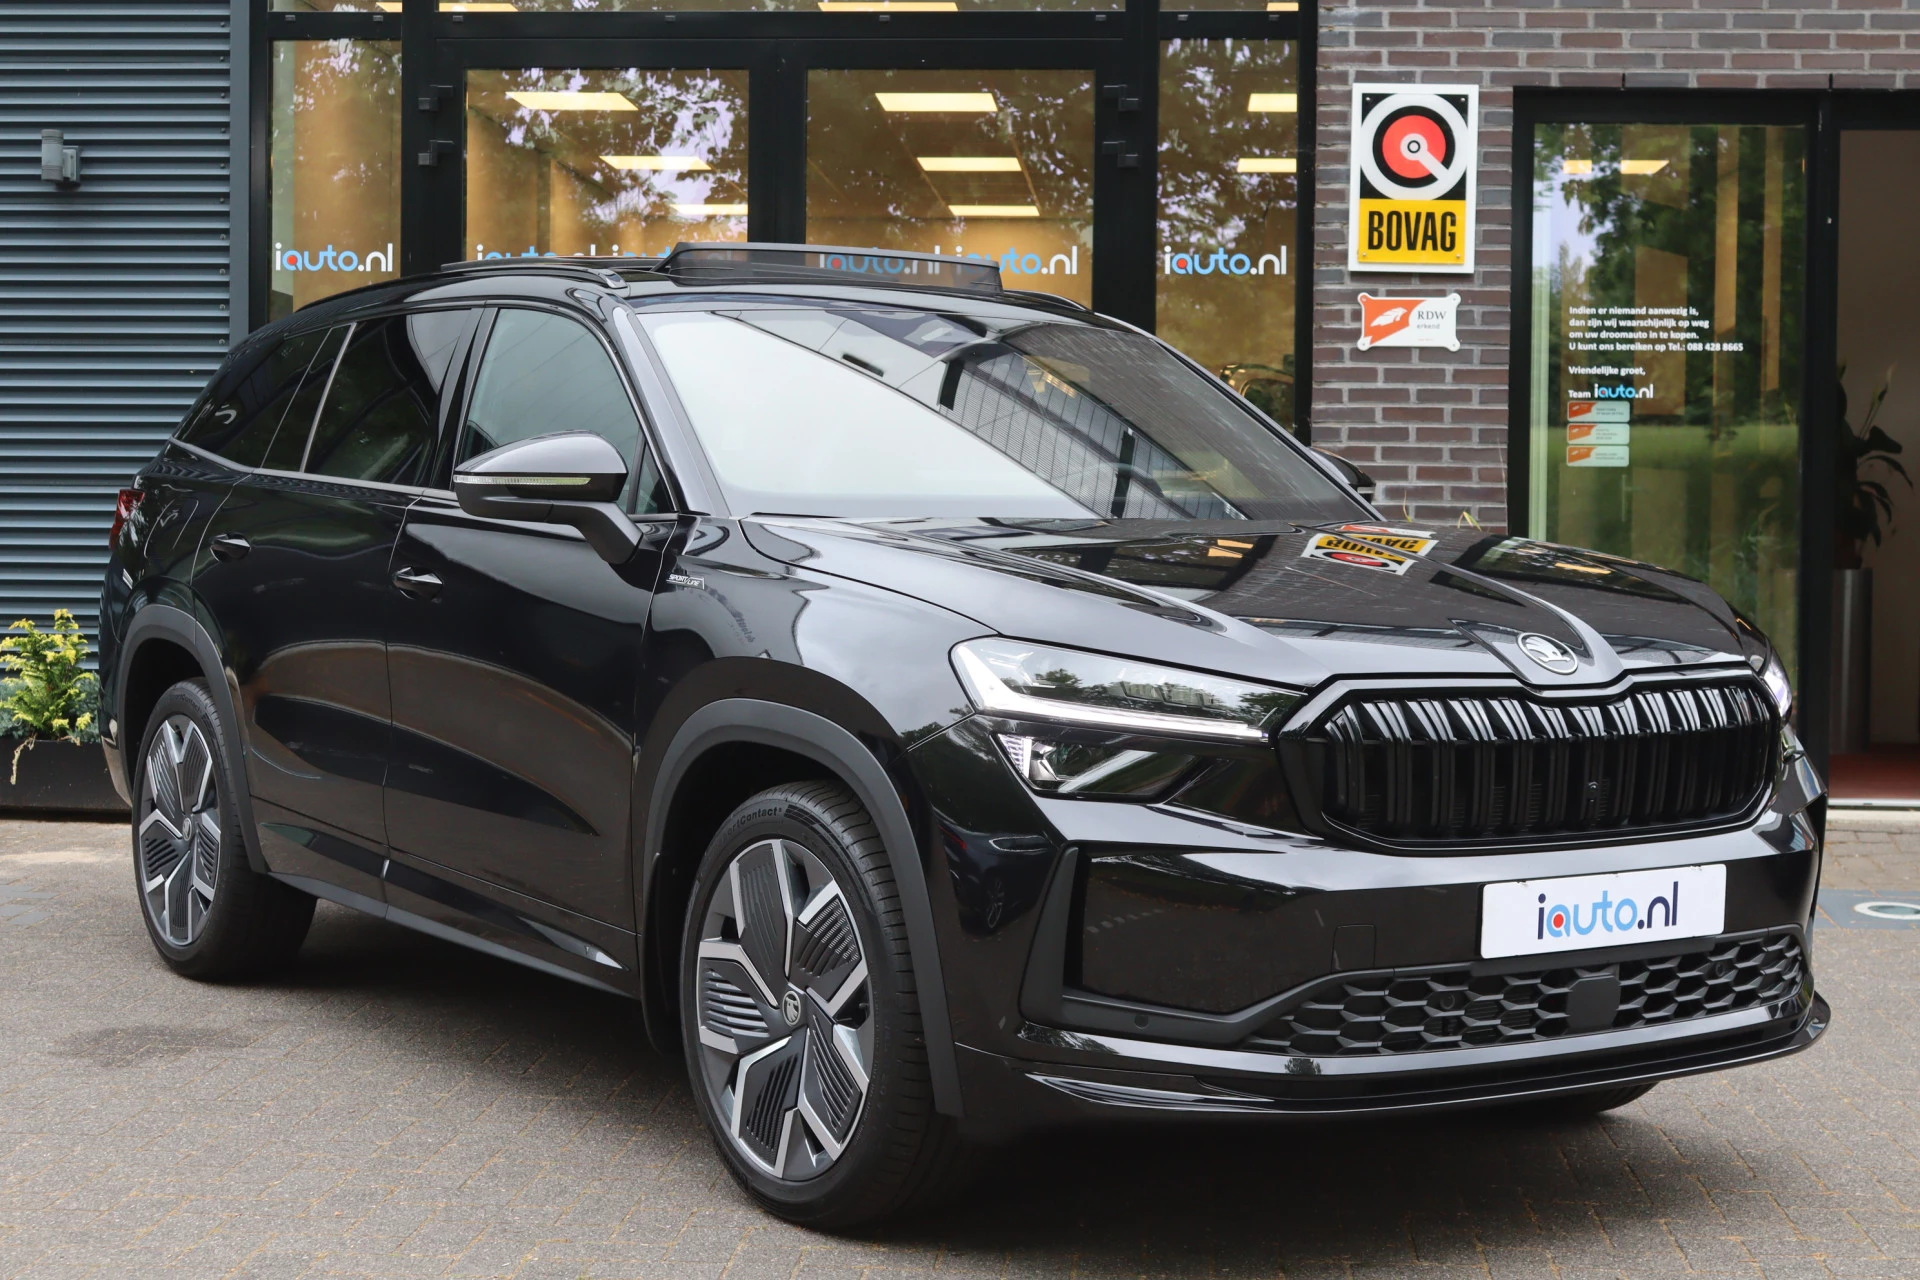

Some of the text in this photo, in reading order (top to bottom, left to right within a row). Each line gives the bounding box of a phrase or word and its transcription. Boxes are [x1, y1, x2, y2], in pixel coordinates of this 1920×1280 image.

[1367, 210, 1457, 252] BOVAG
[274, 242, 393, 273] iauto.nl
[1164, 245, 1287, 275] iauto.nl
[1417, 311, 1447, 320] RDW
[1569, 306, 1596, 315] Indien
[1609, 306, 1646, 315] niemand
[1648, 307, 1688, 317] aanwezig
[1689, 306, 1699, 316] is,
[1569, 318, 1709, 329] dan zijn wij waarschijnlijk op weg
[1600, 330, 1647, 338] droomauto
[1649, 330, 1658, 338] in
[1670, 330, 1699, 340] kopen.
[1569, 342, 1576, 350] U
[1577, 342, 1597, 350] kunt
[1616, 342, 1653, 350] bereiken
[1654, 344, 1666, 352] op
[1687, 342, 1703, 351] 088
[1704, 342, 1721, 351] 428
[1722, 342, 1744, 351] 8665
[1568, 366, 1646, 376] Vriendelijke groet,
[1568, 383, 1654, 398] Team iauto.nl
[1537, 881, 1679, 940] iauto.nl
